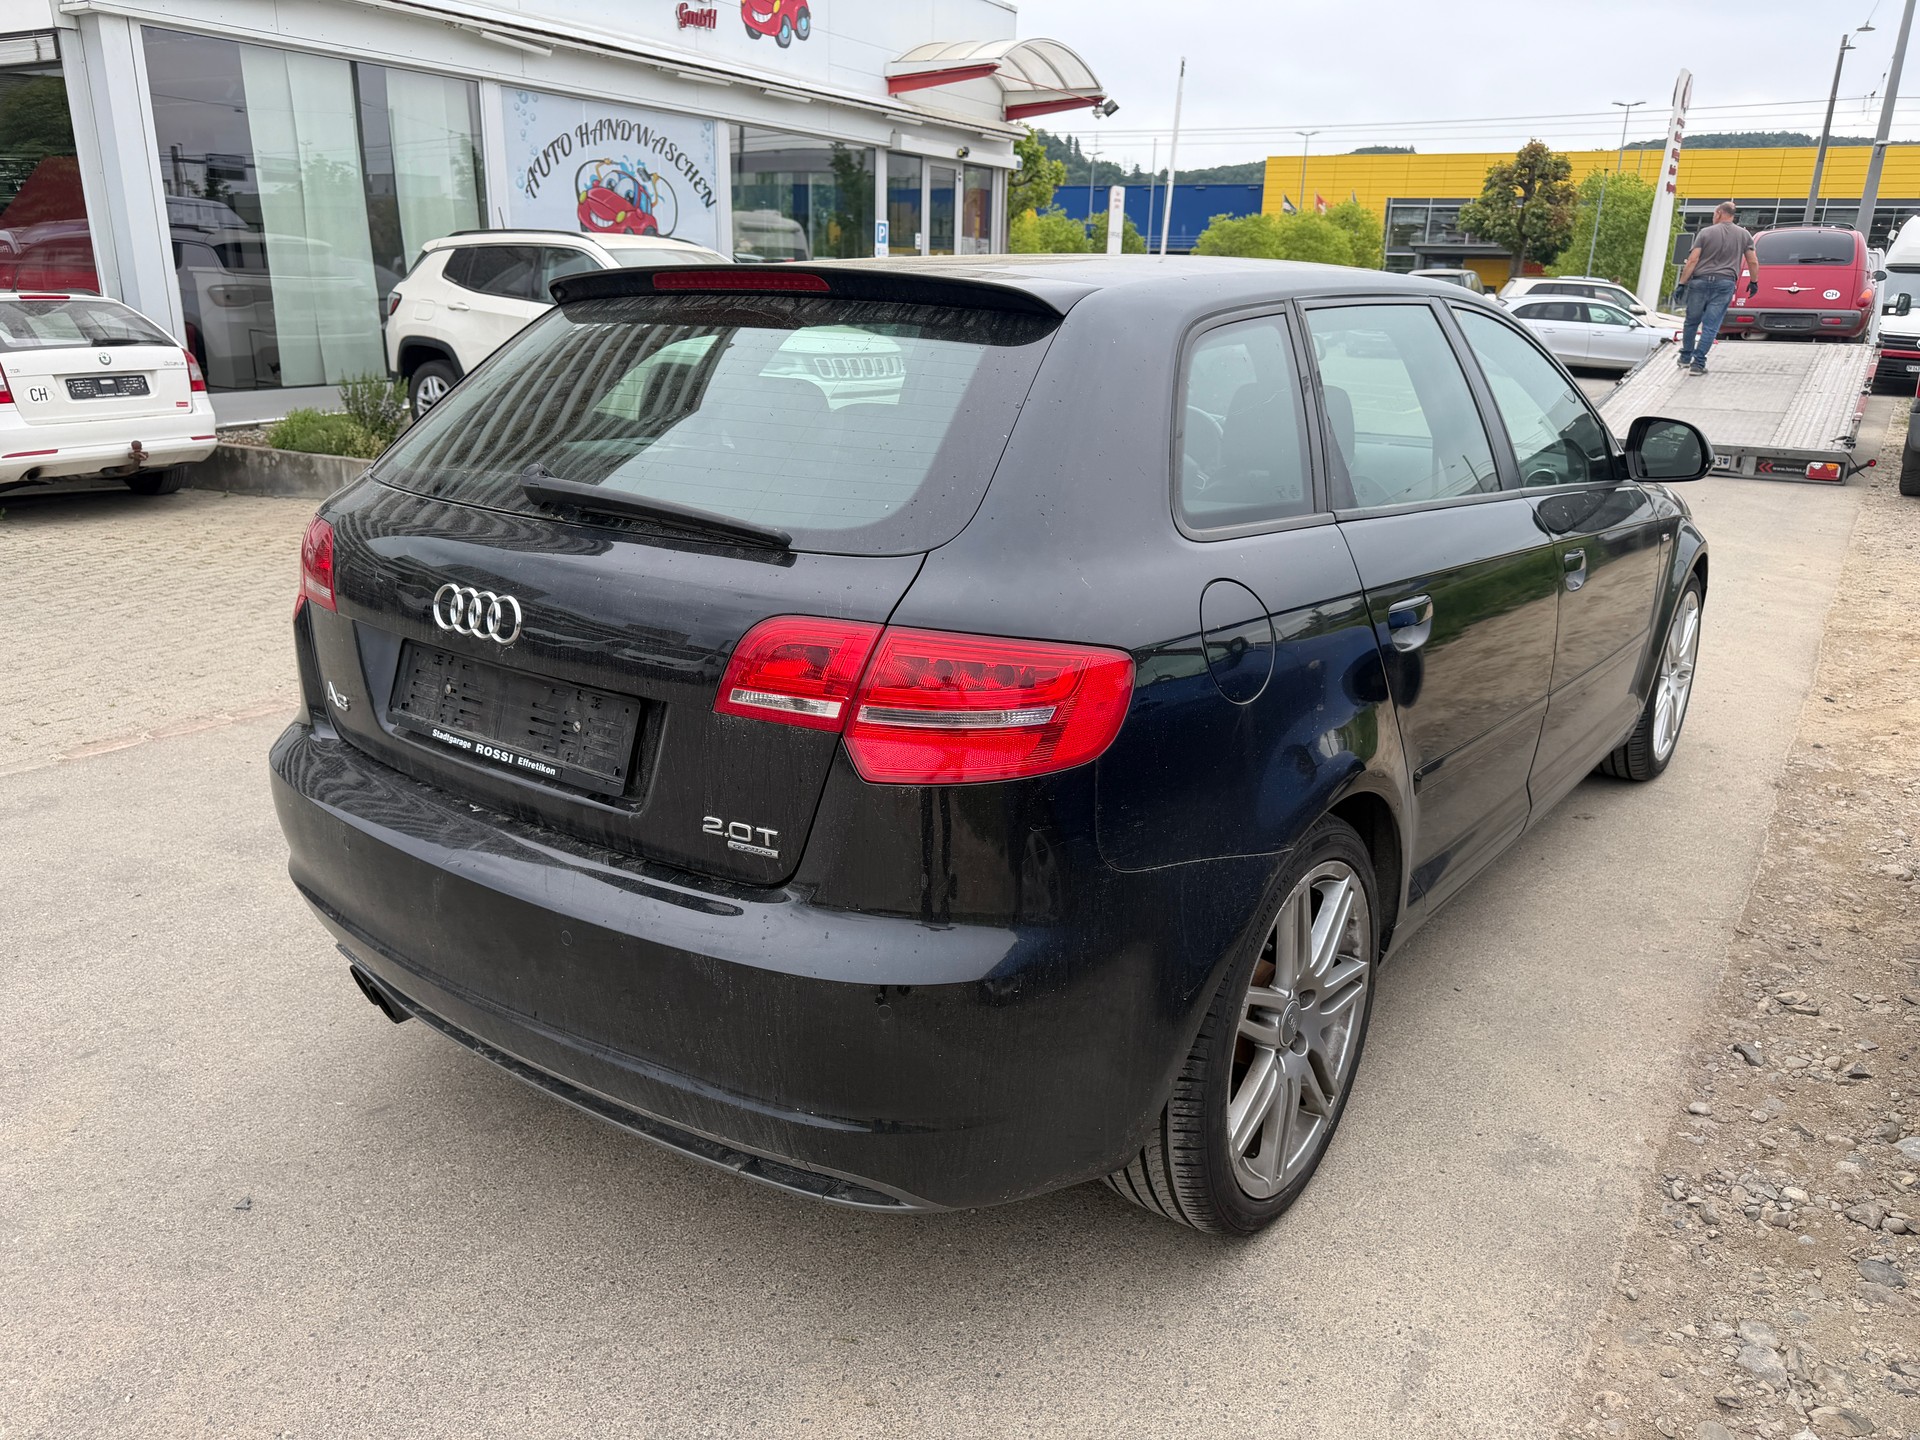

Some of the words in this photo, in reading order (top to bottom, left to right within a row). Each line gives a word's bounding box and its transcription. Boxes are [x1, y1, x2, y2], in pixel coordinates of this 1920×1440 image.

[677, 2, 717, 29] GmbH
[525, 132, 572, 199] AUTO
[575, 118, 717, 209] HANDWASCHEN
[878, 225, 886, 242] P
[30, 387, 48, 401] CH
[327, 681, 348, 711] A3
[432, 728, 472, 749] Stadtgarage
[475, 743, 514, 764] ROSSI
[517, 756, 556, 776] Effretikon
[702, 816, 779, 847] 2.0T
